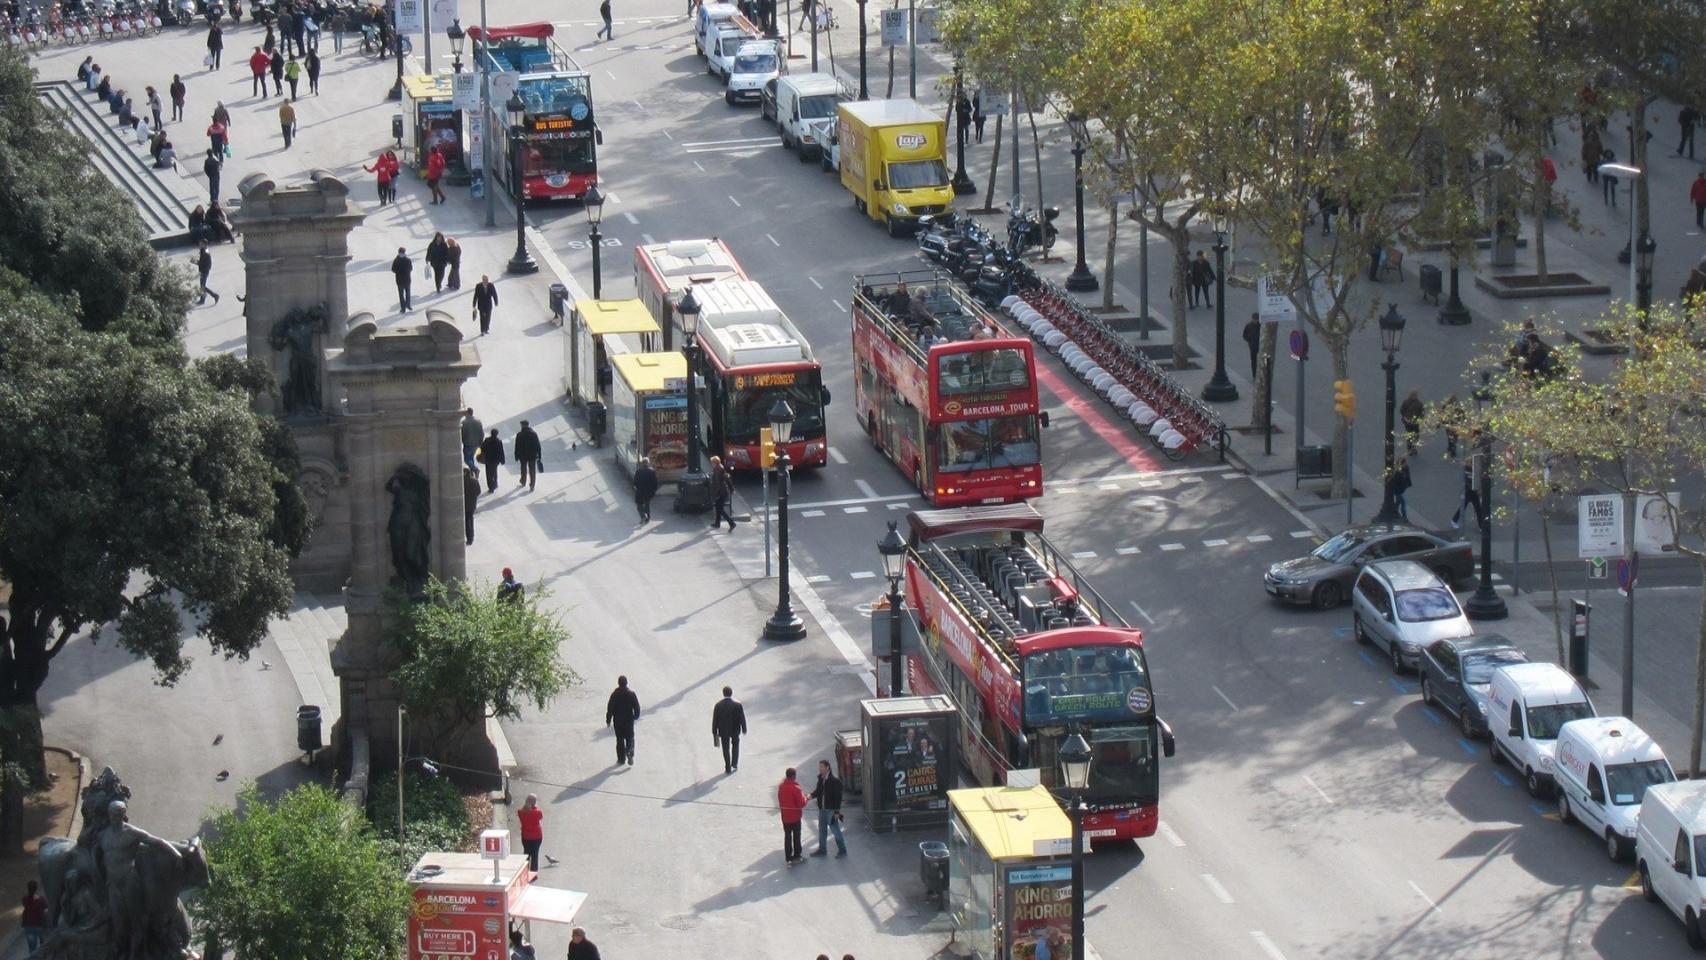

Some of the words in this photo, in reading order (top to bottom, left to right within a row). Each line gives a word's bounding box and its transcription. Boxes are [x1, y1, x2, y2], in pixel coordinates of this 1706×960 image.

[535, 121, 546, 129] BUS
[736, 376, 744, 390] 9
[963, 404, 1005, 416] BARCELONA
[1009, 402, 1029, 411] TOUR
[650, 411, 676, 424] KING
[649, 423, 688, 435] AHORR
[1054, 703, 1086, 711] GREEN
[1088, 701, 1120, 709] ROUTE
[894, 770, 907, 789] 2
[895, 789, 906, 797] EN
[909, 783, 938, 793] CRISIS
[427, 895, 477, 905] BARCELONA
[1014, 885, 1050, 905] KING
[1014, 903, 1073, 920] AHORRO
[423, 932, 440, 940] BUY
